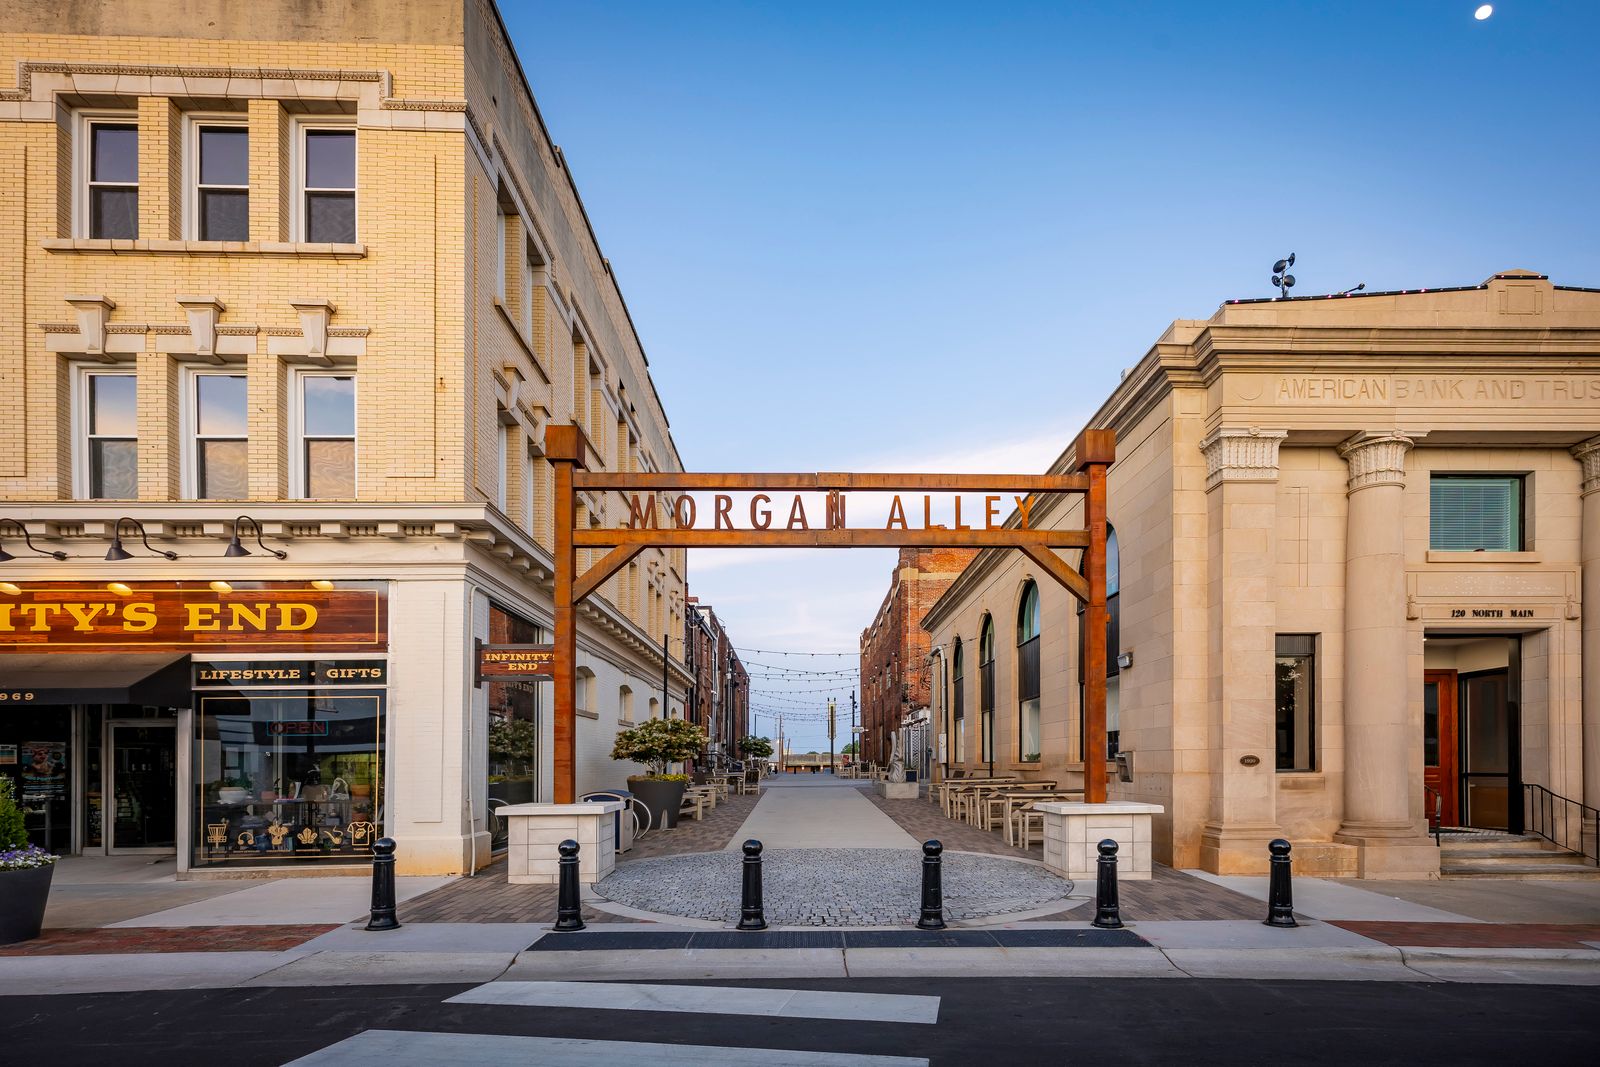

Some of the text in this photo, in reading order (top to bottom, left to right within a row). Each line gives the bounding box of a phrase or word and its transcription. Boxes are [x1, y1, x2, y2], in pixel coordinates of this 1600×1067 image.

[1278, 378, 1387, 400] AMERICAN
[1394, 379, 1466, 400] BANK
[1474, 379, 1526, 400] AND
[629, 493, 1037, 530] MORGAN ALLEY
[183, 602, 319, 632] END
[1451, 609, 1534, 618] 120 NORTH MAIN
[485, 653, 554, 661] INFINITY'
[508, 663, 538, 671] END
[200, 668, 382, 680] LIFESTYLE GIFTS
[269, 721, 326, 735] OPEN
